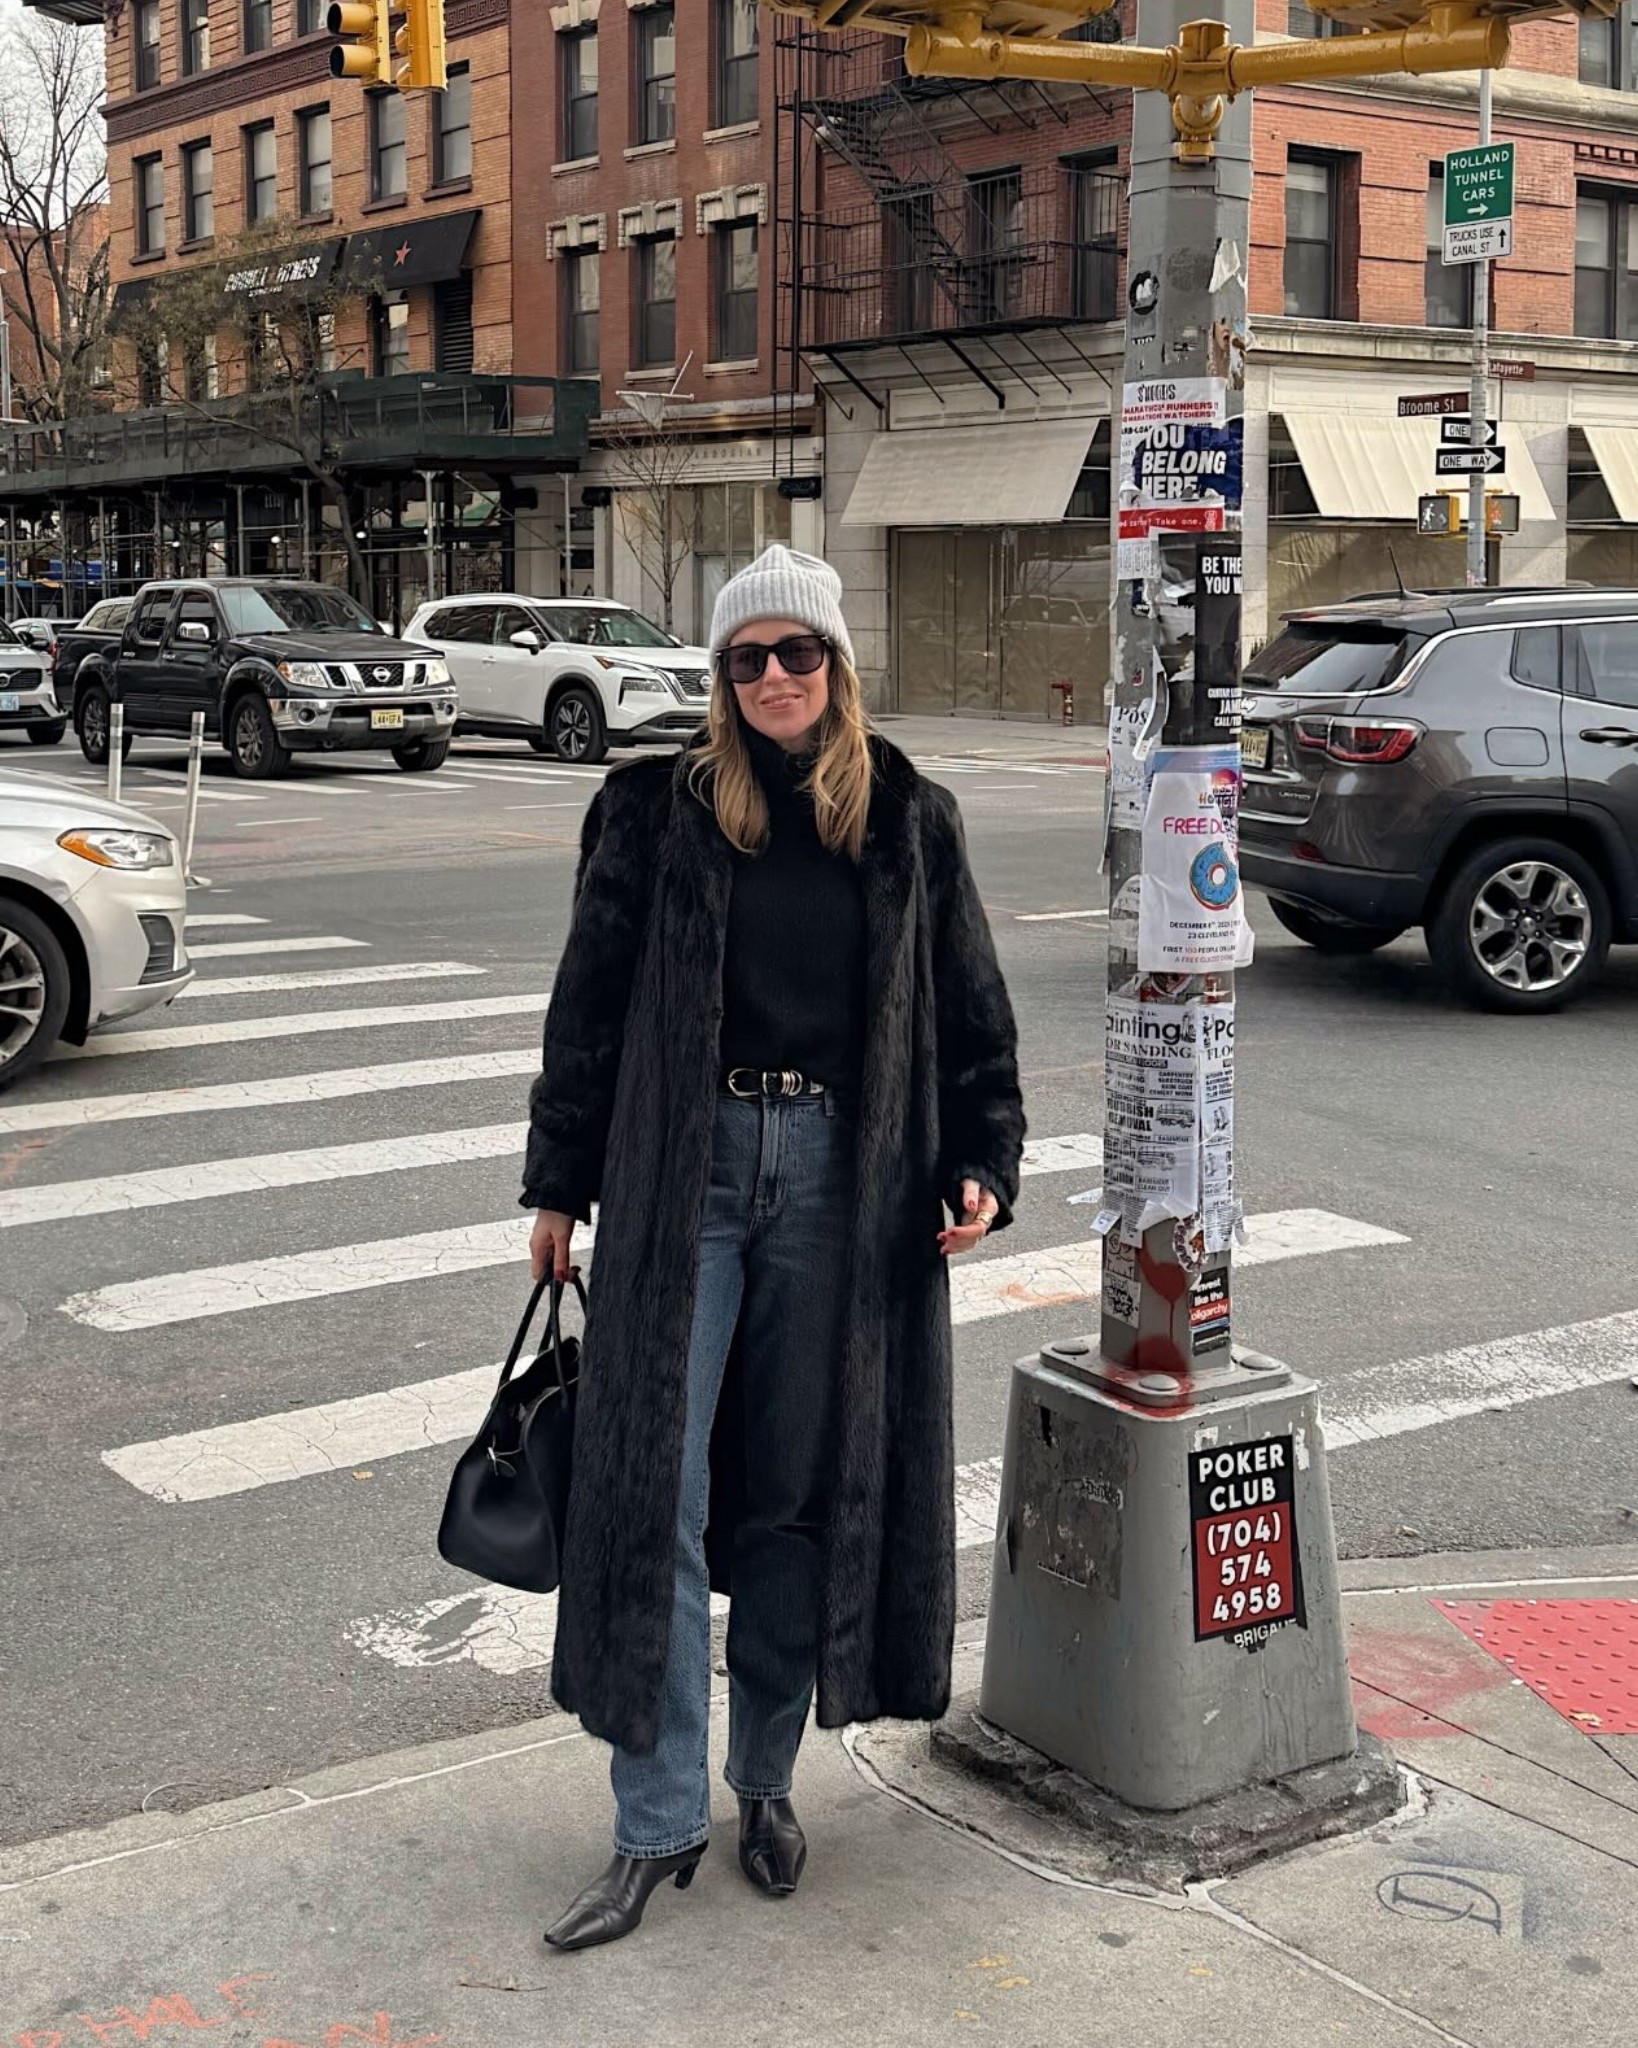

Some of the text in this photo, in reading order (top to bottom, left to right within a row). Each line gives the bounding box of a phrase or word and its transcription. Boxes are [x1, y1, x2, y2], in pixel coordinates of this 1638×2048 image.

[1450, 150, 1510, 171] HOLLAND
[1454, 169, 1504, 187] TUNNEL
[1462, 187, 1495, 201] CARS
[1449, 226, 1494, 242] TRUCKS USE
[1452, 241, 1490, 256] CANAL ST
[1488, 361, 1524, 376] Lafayette
[1399, 398, 1455, 415] Broome St
[1144, 425, 1185, 449] YOU
[1449, 424, 1466, 436] ONE
[1142, 450, 1227, 474] BELONG
[1442, 455, 1491, 467] ONE WAY
[1155, 518, 1177, 526] Take
[1202, 556, 1242, 574] BE THE
[1204, 576, 1230, 594] YOU
[1123, 1040, 1192, 1059] SANDING
[1191, 1302, 1228, 1321] oligarchy
[1199, 1443, 1285, 1483] POKER
[1209, 1477, 1276, 1512] CLUB
[1207, 1511, 1281, 1556] (704)
[1221, 1550, 1271, 1586] 574
[1212, 1582, 1281, 1622] 4958
